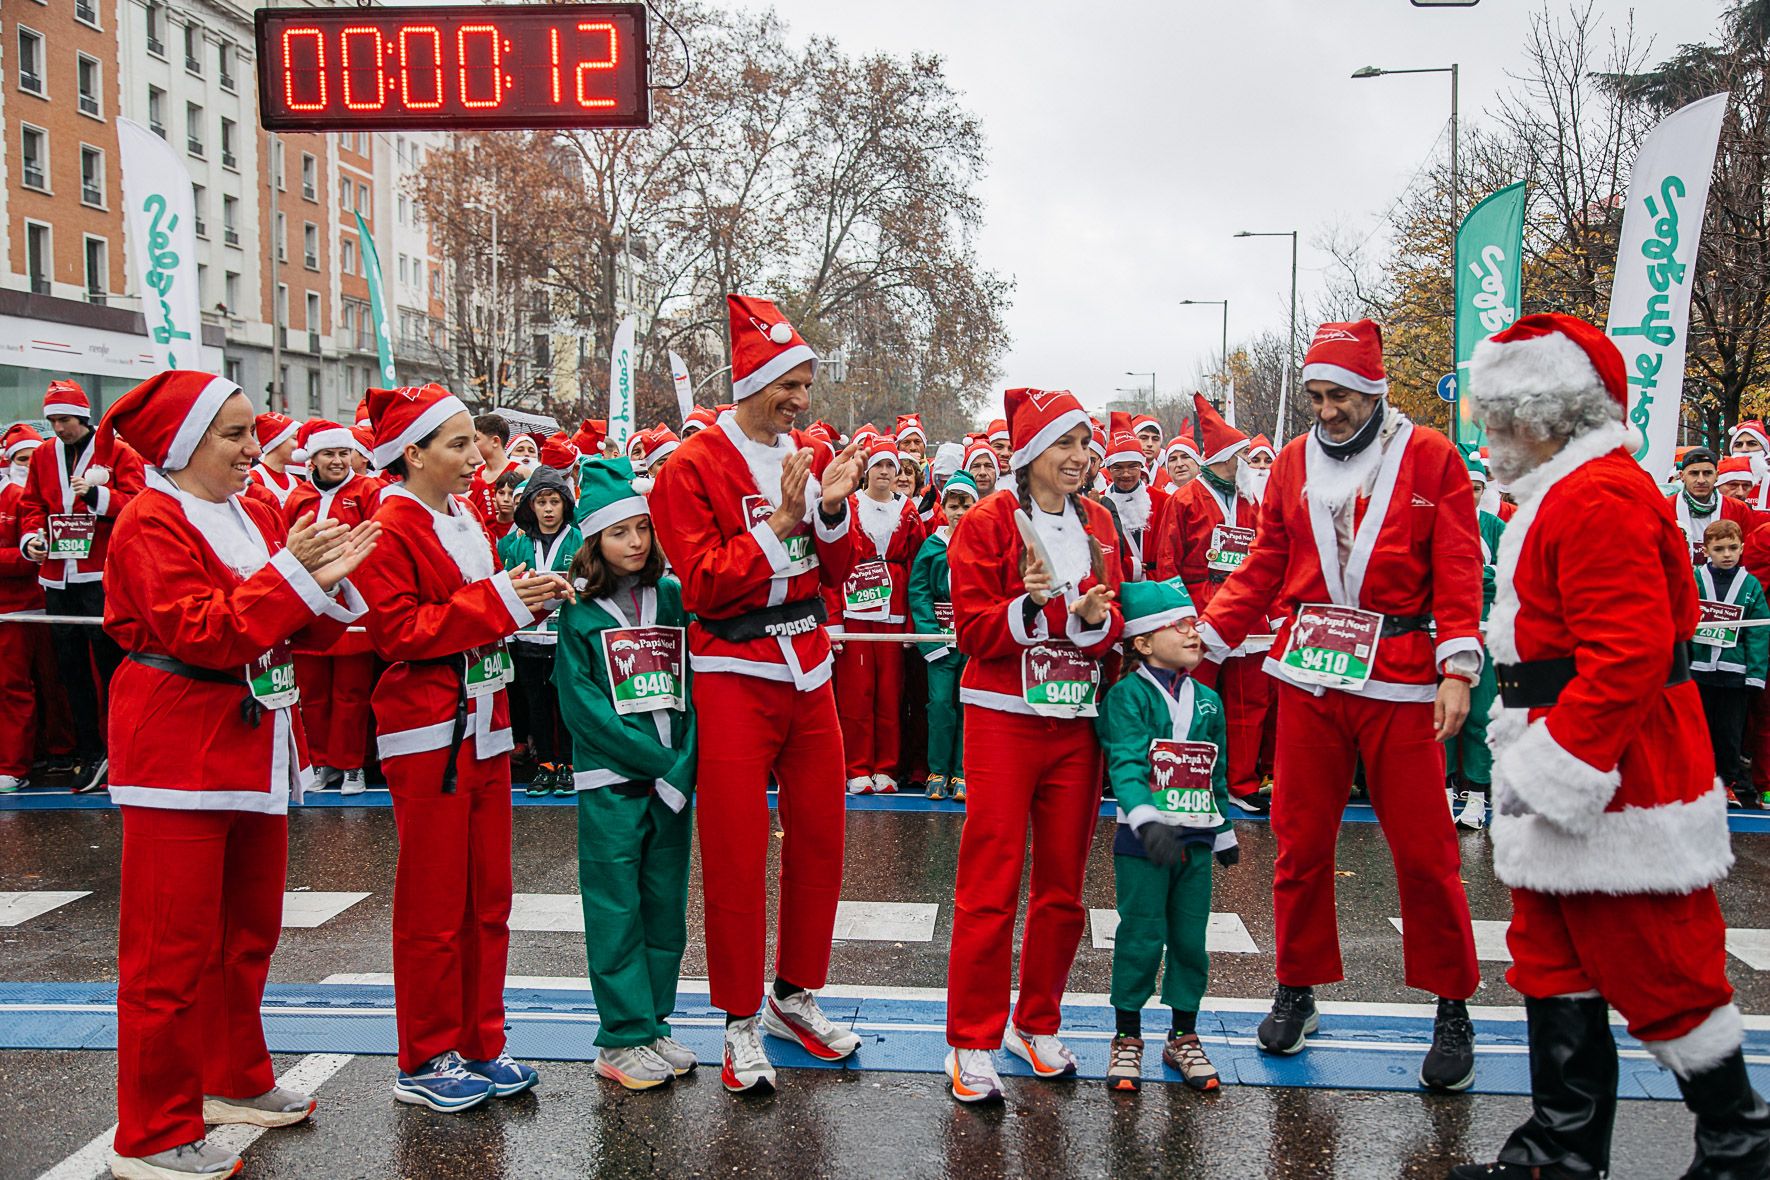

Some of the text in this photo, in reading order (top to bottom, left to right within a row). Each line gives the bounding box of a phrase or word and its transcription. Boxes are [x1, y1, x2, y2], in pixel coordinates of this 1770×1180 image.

[283, 24, 617, 110] 00:00:12
[1612, 175, 1686, 347] Inglés
[1464, 245, 1515, 340] glés
[58, 539, 86, 551] 5304
[856, 587, 882, 603] 2961
[1346, 619, 1371, 632] Noel
[639, 638, 661, 649] Papá
[1301, 648, 1349, 674] 9410
[1166, 789, 1211, 811] 9408
